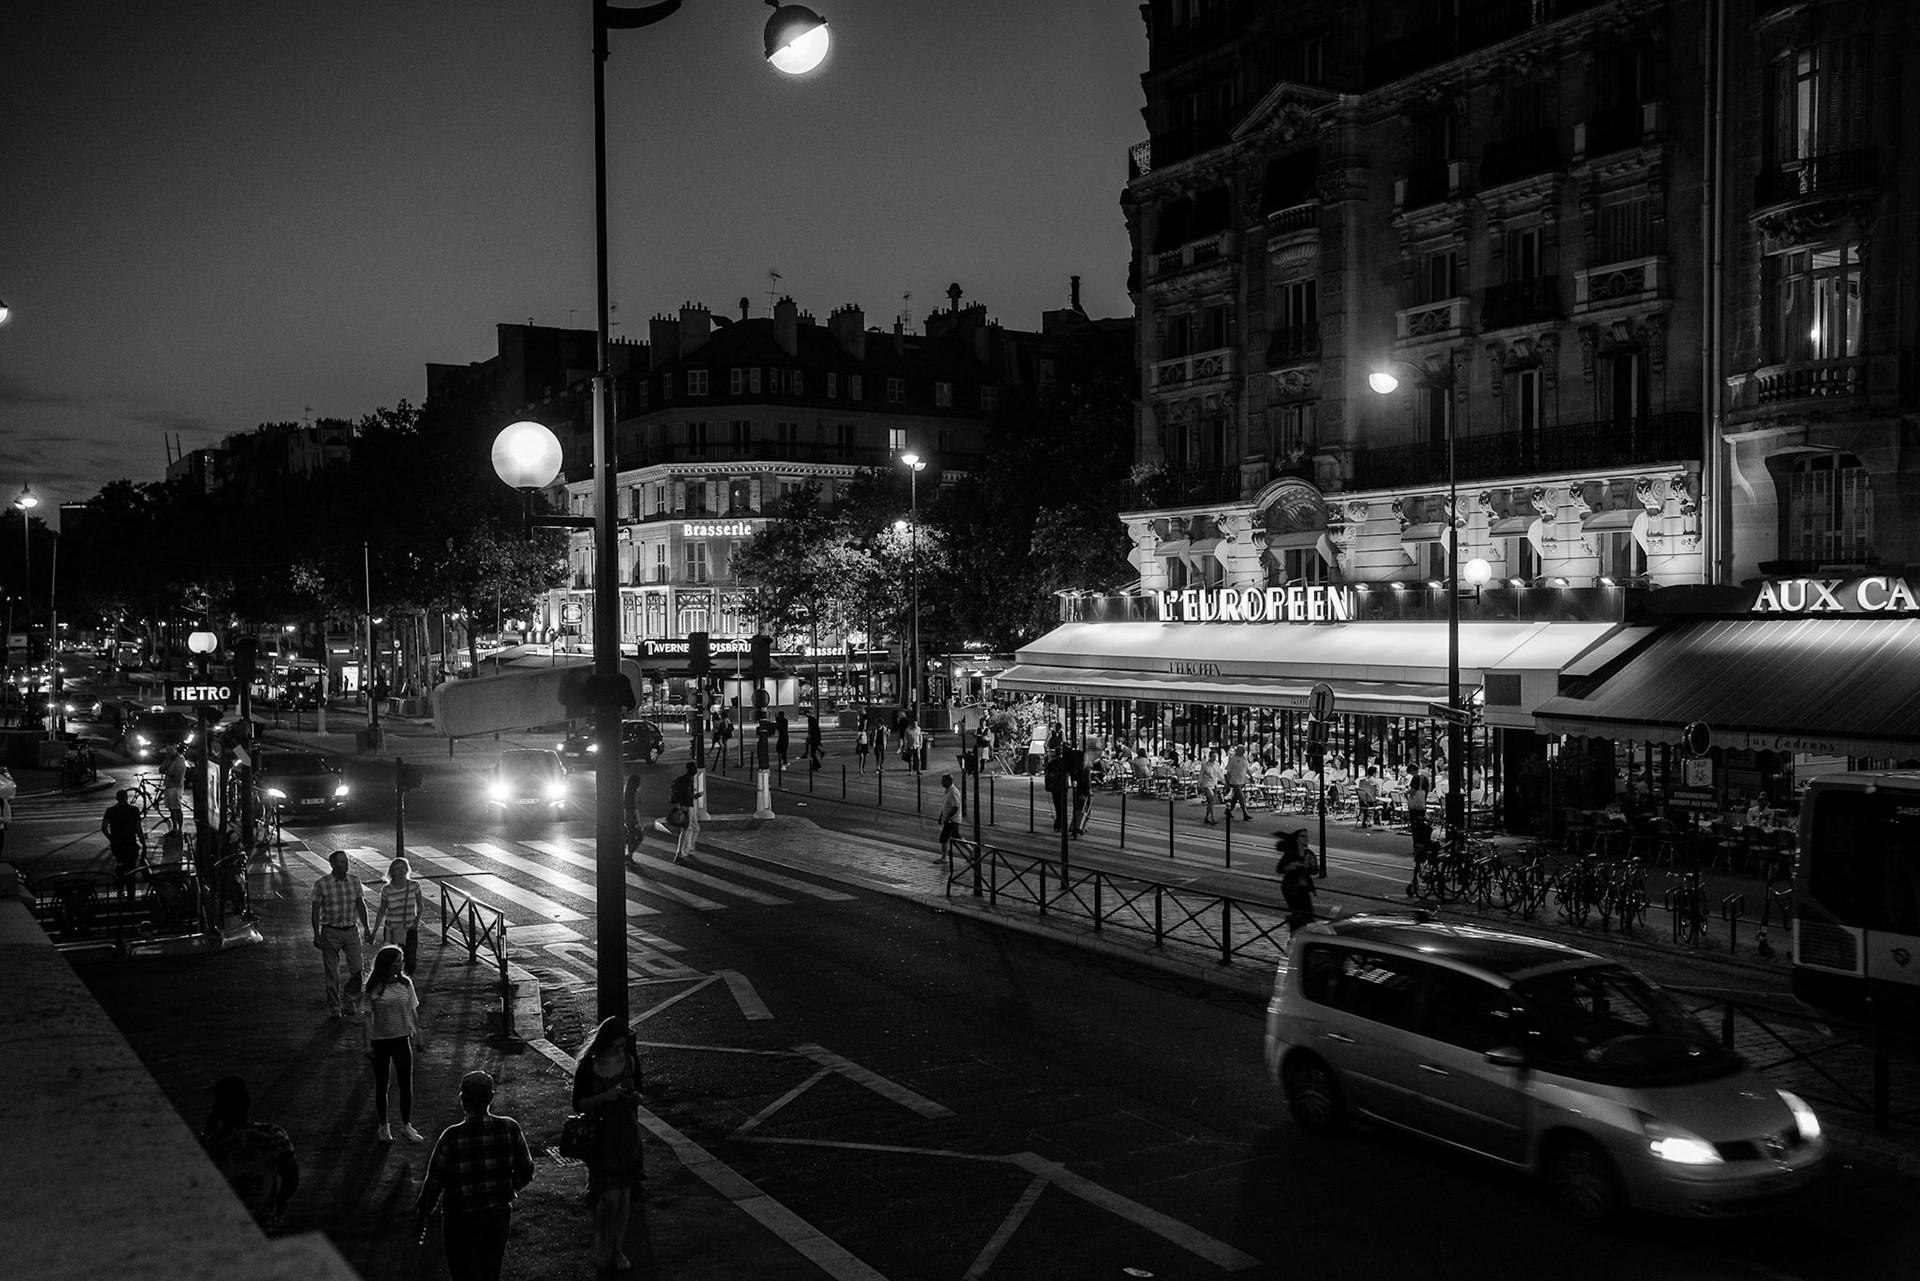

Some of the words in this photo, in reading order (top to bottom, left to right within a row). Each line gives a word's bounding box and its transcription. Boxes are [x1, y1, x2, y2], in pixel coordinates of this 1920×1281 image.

[683, 522, 751, 536] Brasserie
[1751, 580, 1843, 611] AUX
[1857, 577, 1920, 611] CA
[1159, 586, 1354, 621] L'EUROPEEN
[644, 641, 689, 655] TAVERNE
[173, 686, 231, 700] METRO
[1775, 736, 1834, 751] Cadrans
